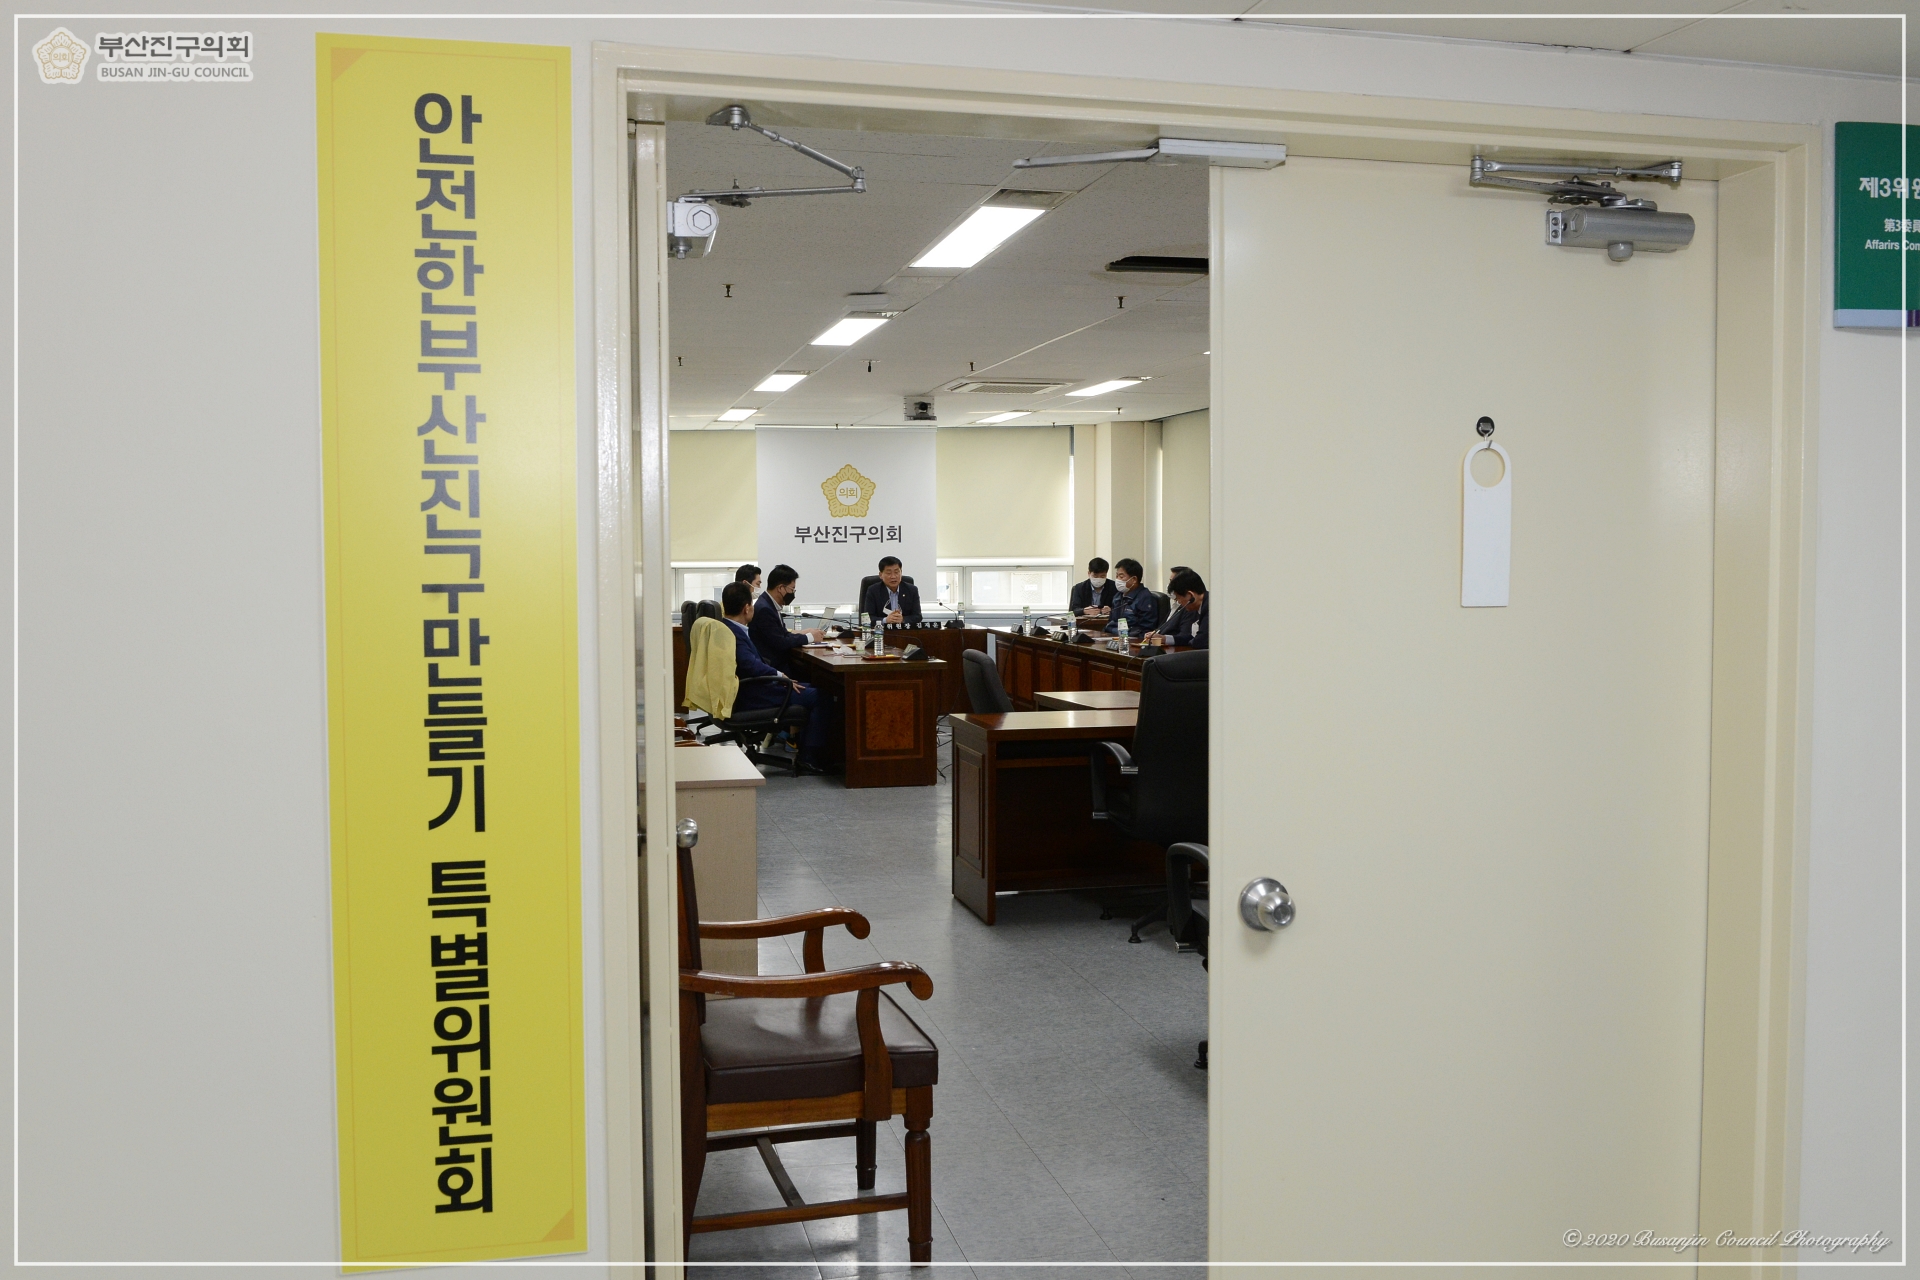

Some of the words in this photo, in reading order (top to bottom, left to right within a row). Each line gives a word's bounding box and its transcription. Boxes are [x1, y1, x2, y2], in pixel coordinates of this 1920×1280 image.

[1865, 239, 1900, 250] Affarirs
[839, 487, 858, 498] 의회
[794, 525, 902, 543] 부산진구의회
[427, 859, 494, 1215] 특별위원회
